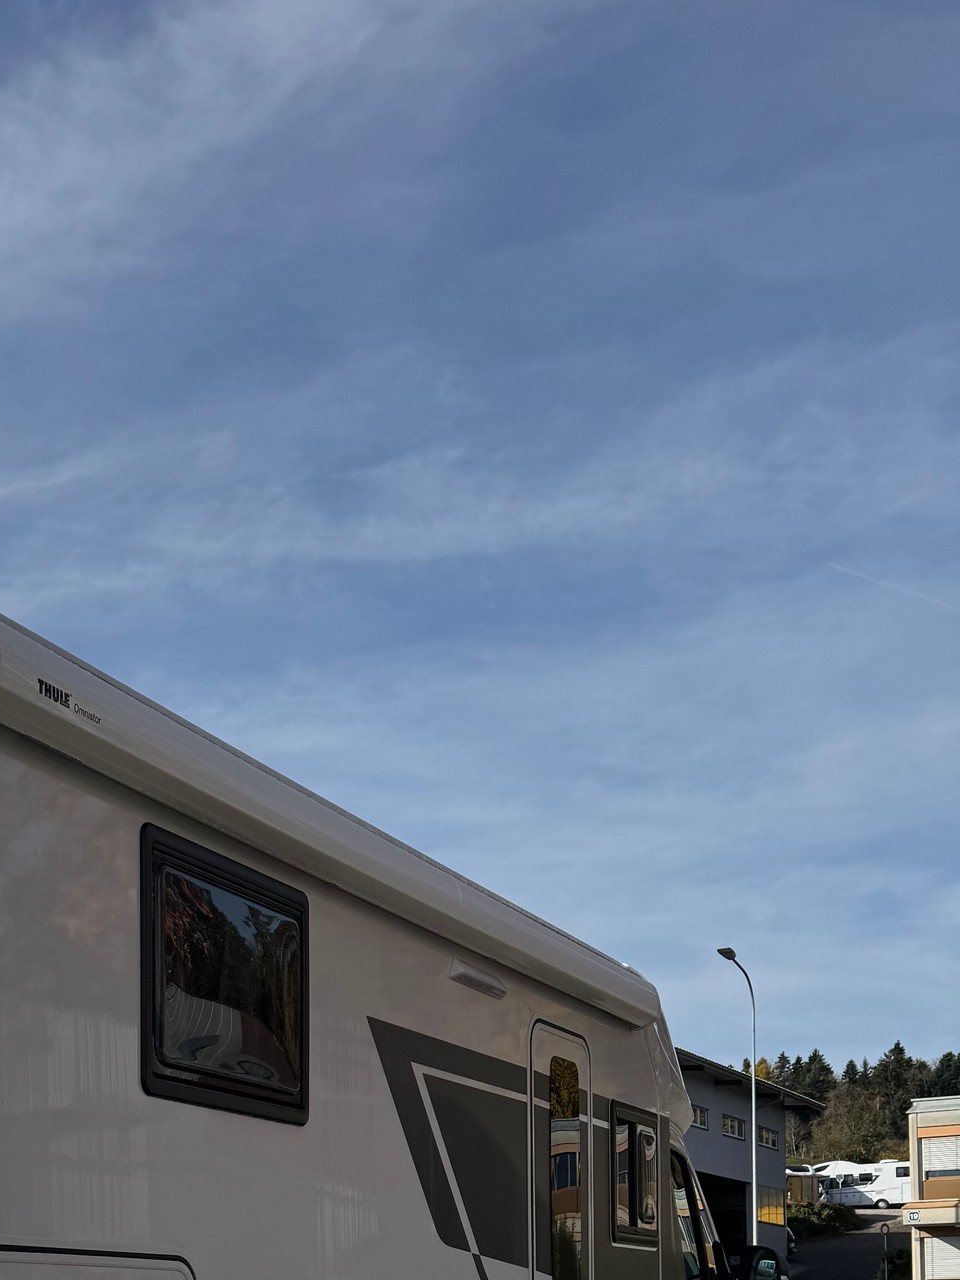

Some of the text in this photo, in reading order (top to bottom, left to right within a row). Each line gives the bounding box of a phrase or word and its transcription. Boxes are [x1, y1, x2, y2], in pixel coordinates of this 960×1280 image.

[37, 678, 102, 724] THULE Omnistor
[909, 1212, 919, 1220] 19
